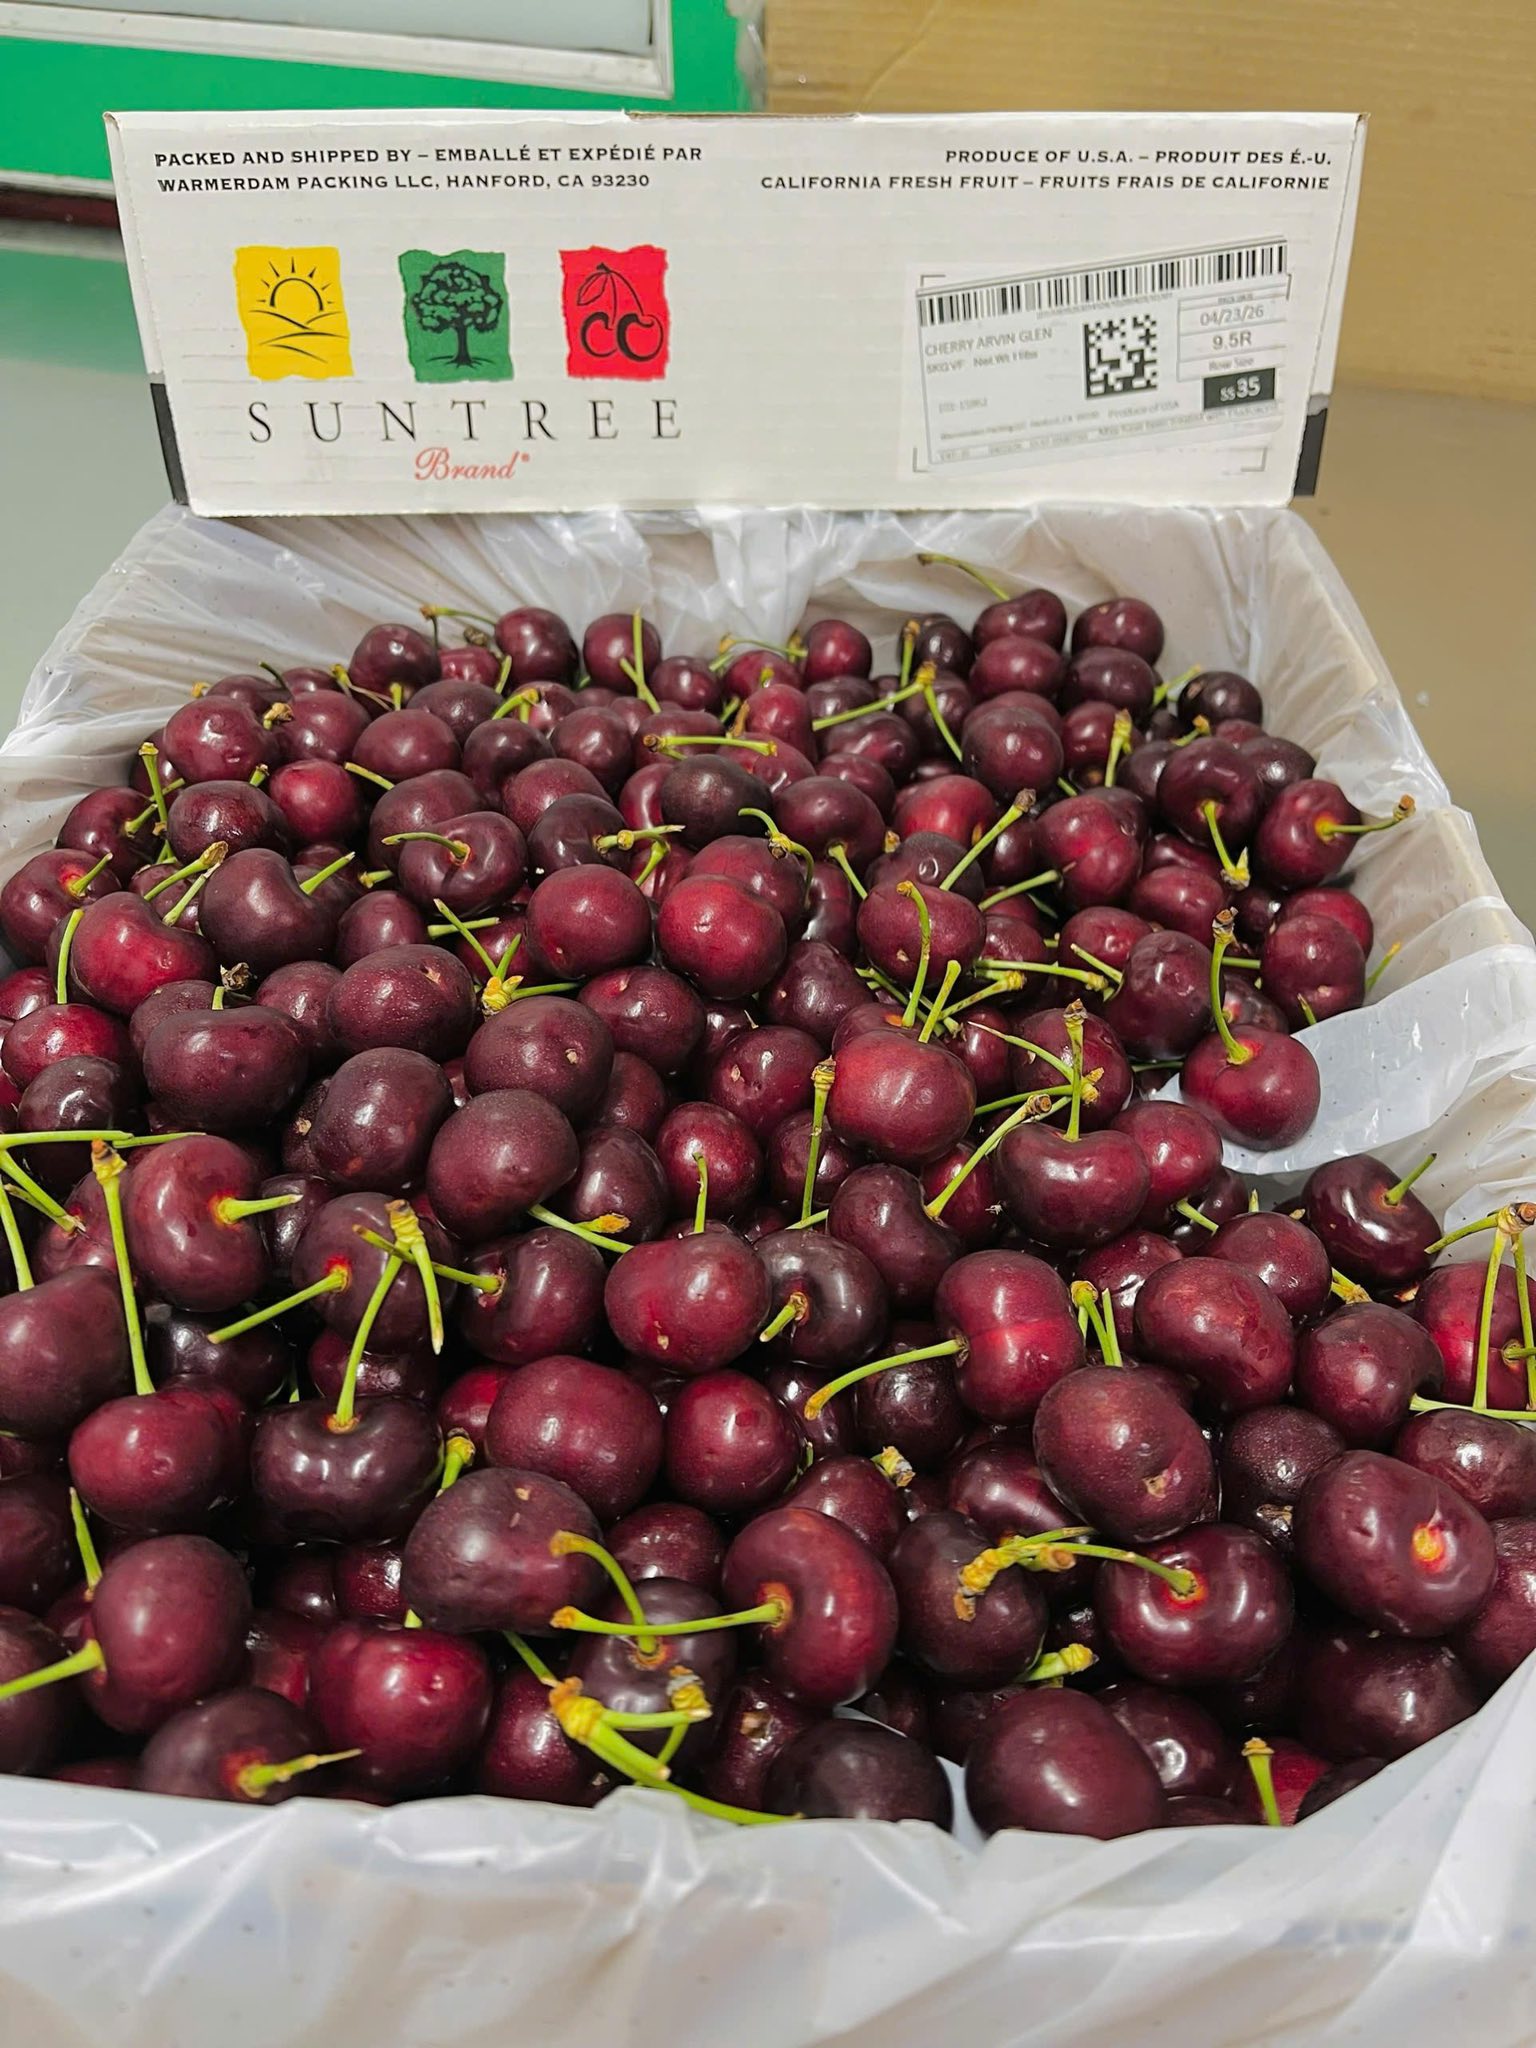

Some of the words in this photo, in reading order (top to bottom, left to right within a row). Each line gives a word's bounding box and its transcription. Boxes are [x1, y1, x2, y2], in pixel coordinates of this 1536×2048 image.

[154, 152, 235, 167] PACKED
[242, 151, 284, 164] AND
[291, 149, 379, 163] SHIPPED
[386, 149, 411, 162] BY
[435, 144, 531, 161] EMBALLÉ
[538, 148, 561, 161] ET
[569, 144, 655, 161] EXPÉDIÉ
[663, 148, 702, 161] PAR
[946, 150, 1039, 163] PRODUCE
[1045, 150, 1071, 163] OF
[1078, 150, 1133, 163] U.S.A.
[1155, 150, 1241, 163] PRODUIT
[1247, 151, 1283, 164] DES
[1290, 148, 1331, 165] É.-U.
[157, 177, 290, 192] WARMERDAM
[297, 176, 388, 189] PACKING
[395, 175, 440, 189] LLC,
[446, 175, 551, 189] HANFORD,
[557, 175, 584, 187] CA
[591, 174, 650, 187] 93230
[761, 176, 881, 189] CALIFORNIA
[889, 176, 952, 188] FRESH
[960, 176, 1018, 188] FRUIT
[1040, 176, 1110, 188] FRUITS
[1117, 176, 1174, 188] FRAIS
[1182, 176, 1206, 188] DE
[1212, 176, 1329, 190] CALIFORNIE
[1200, 304, 1264, 326] 04/23/26
[925, 339, 974, 357] CHERRY
[976, 333, 1016, 350] ARVIN
[1018, 328, 1053, 342] GLEN
[1212, 330, 1252, 350] 9.5R
[248, 400, 682, 442] SUNTREE
